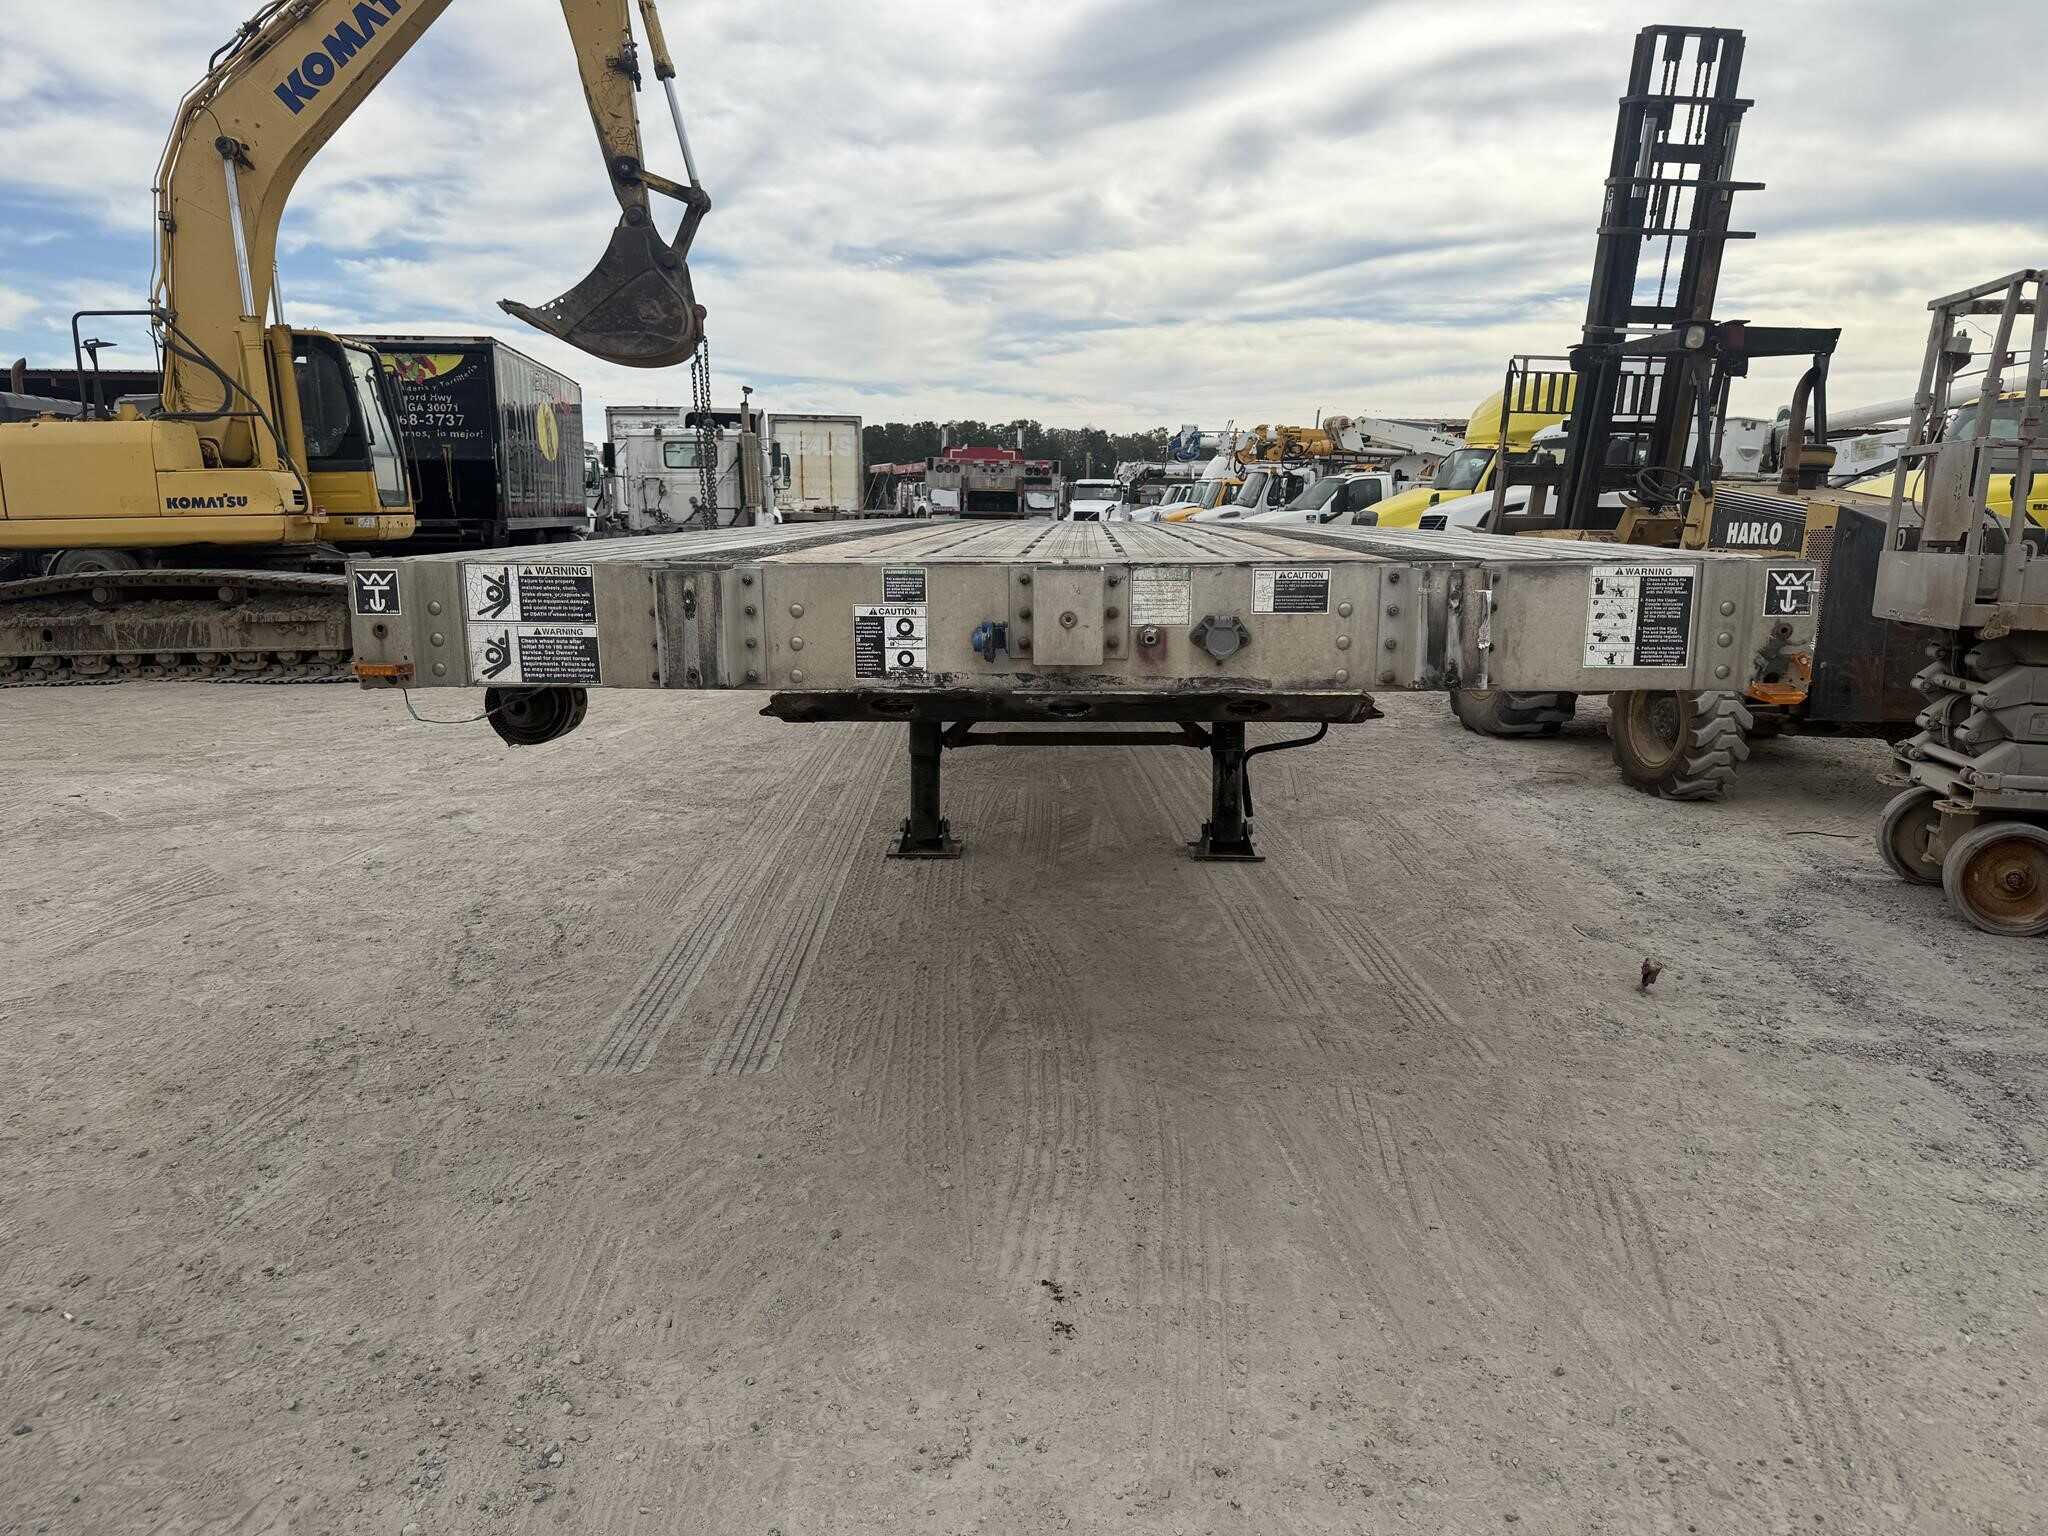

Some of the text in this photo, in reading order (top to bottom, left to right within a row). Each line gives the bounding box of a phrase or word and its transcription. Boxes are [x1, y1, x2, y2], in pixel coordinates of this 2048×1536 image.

[430, 393, 452, 404] Hwy
[408, 402, 459, 412] GA 30071
[166, 493, 248, 509] KOMATSU
[1726, 522, 1783, 545] HARLO
[535, 566, 588, 576] WARNING
[1287, 571, 1324, 579] CAUTION
[1625, 567, 1673, 576] WARNING
